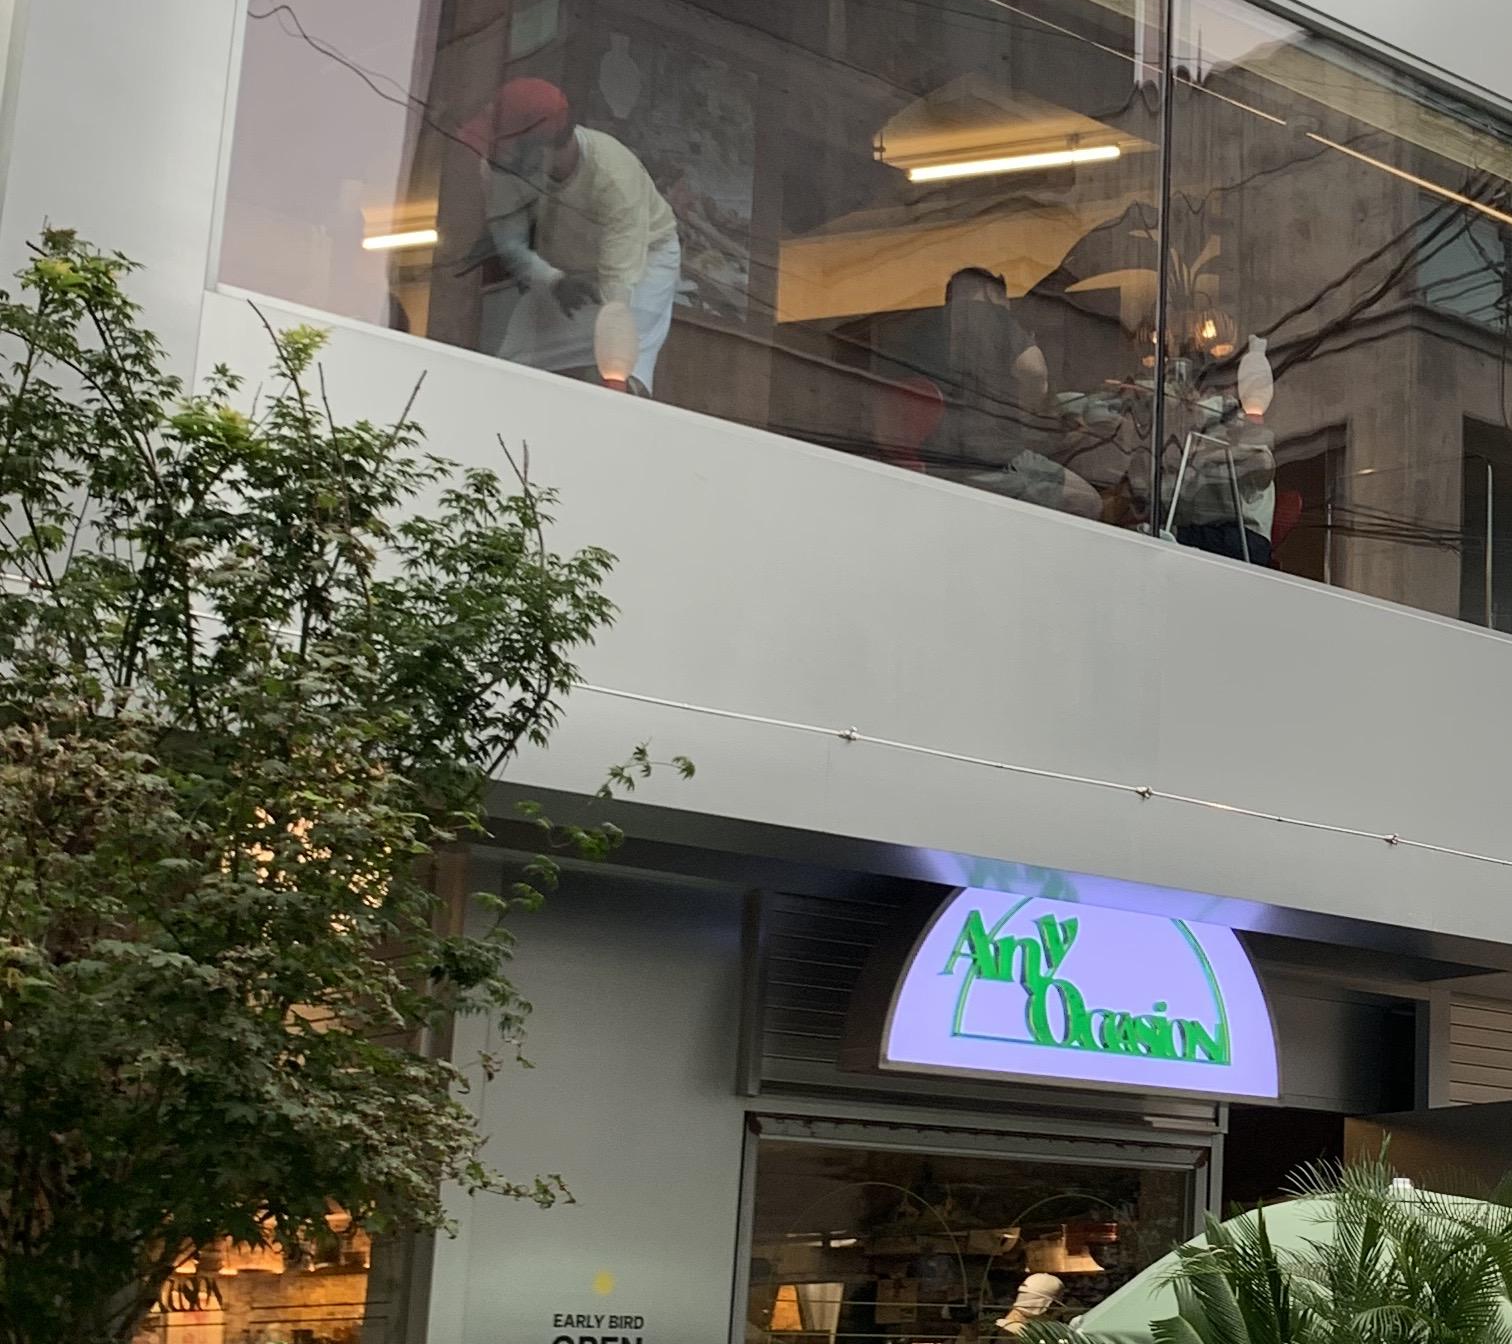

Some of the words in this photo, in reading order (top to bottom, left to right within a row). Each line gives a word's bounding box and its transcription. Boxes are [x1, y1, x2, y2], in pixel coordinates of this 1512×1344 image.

[937, 909, 1079, 983] Any
[553, 1313, 605, 1329] EARLY
[608, 1315, 645, 1329] BIRD
